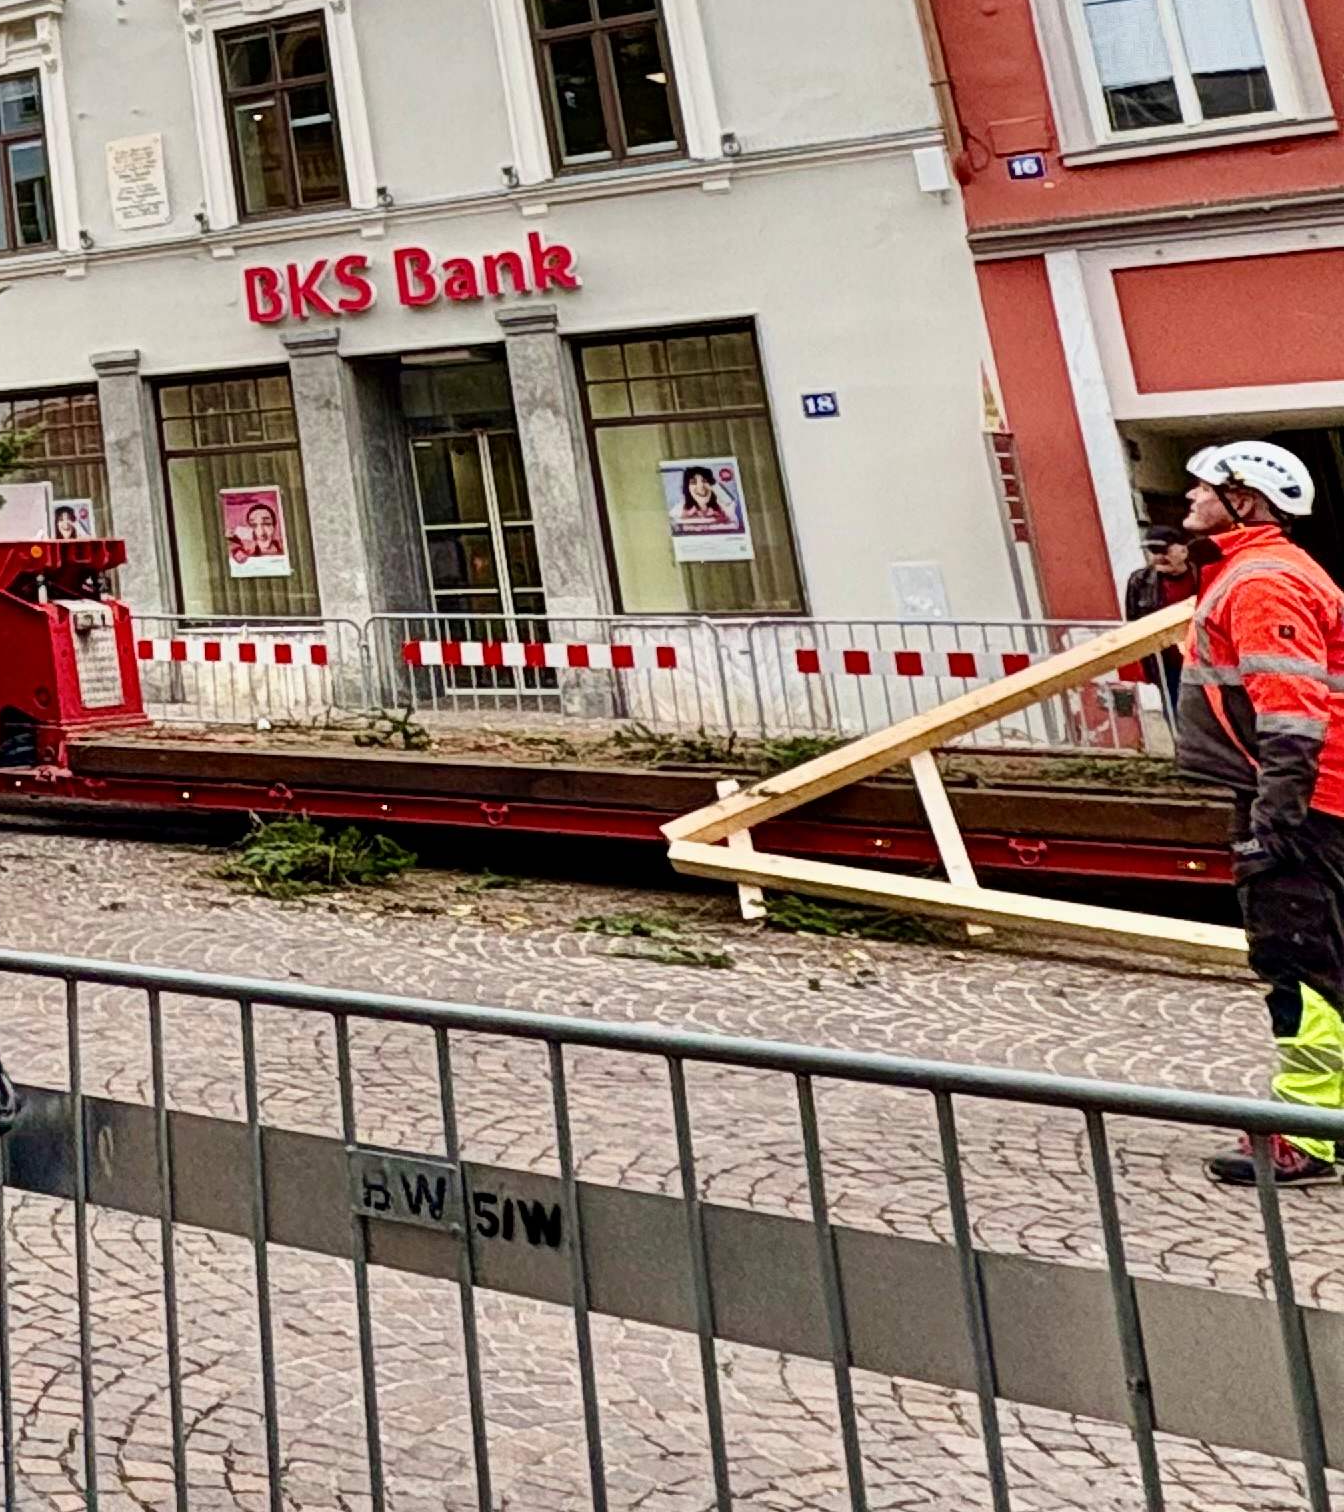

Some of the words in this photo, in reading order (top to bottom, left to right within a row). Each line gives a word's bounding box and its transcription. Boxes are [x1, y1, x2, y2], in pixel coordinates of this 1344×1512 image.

[1012, 158, 1039, 176] 16
[243, 254, 374, 324] BKS
[393, 231, 580, 307] Bank
[806, 395, 835, 414] 18
